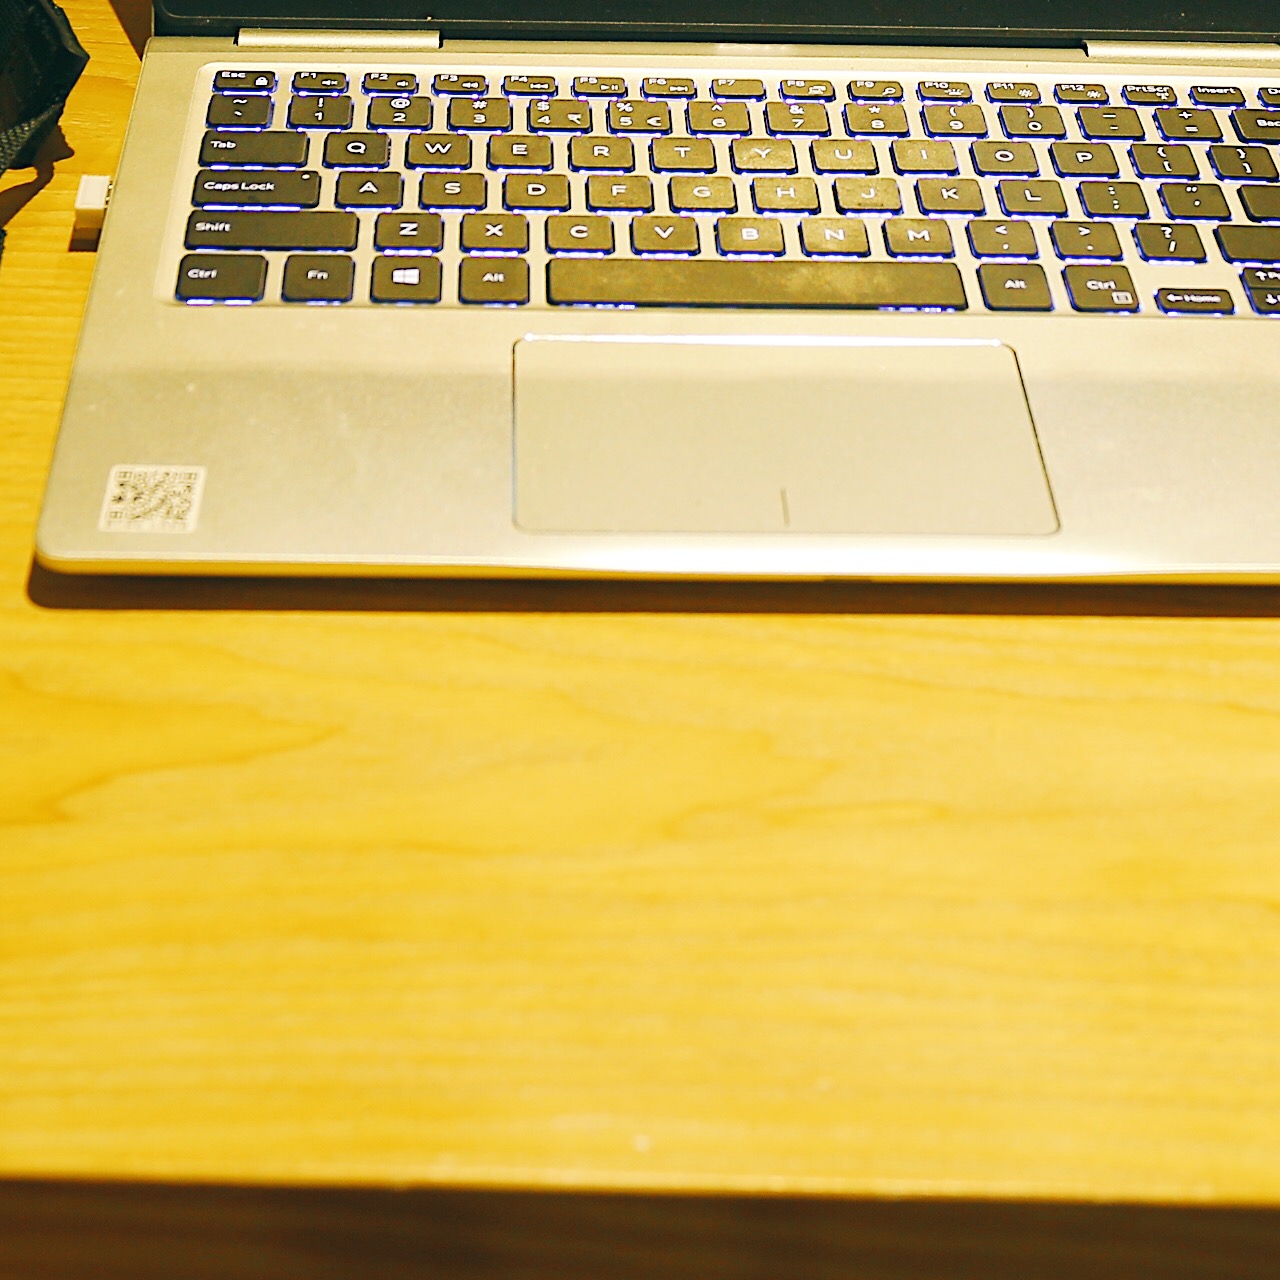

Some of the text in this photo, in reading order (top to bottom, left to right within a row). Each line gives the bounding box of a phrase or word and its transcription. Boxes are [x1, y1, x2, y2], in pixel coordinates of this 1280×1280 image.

[221, 71, 246, 79] Esc
[440, 74, 458, 82] F3
[1197, 86, 1236, 94] Insert
[393, 112, 407, 122] 2
[473, 114, 487, 123] 3
[538, 116, 551, 125] 4
[620, 116, 633, 126] 5
[712, 118, 726, 128] 6
[792, 119, 805, 128] 7
[870, 119, 885, 129] 8
[949, 120, 964, 130] 9
[210, 140, 237, 150] Tab
[346, 142, 366, 155] Q
[425, 142, 452, 154] W
[512, 144, 527, 155] E
[594, 146, 610, 157] R
[674, 147, 691, 157] T
[754, 148, 771, 159] Y
[835, 149, 852, 159] U
[995, 150, 1014, 162] O
[1075, 151, 1093, 162] P
[203, 181, 275, 192] Caps Lock
[359, 181, 379, 194] A
[444, 182, 461, 194] S
[527, 183, 547, 195] D
[612, 185, 628, 196] F
[693, 185, 712, 198] G
[776, 187, 796, 198] H
[860, 188, 876, 199] J
[941, 187, 960, 200] K
[1024, 189, 1042, 202] L
[195, 222, 232, 232] Shift
[399, 223, 418, 236] Z
[485, 223, 504, 237] X
[570, 225, 588, 238] C
[653, 226, 675, 239] V
[741, 227, 759, 240] B
[824, 229, 846, 241] N
[907, 230, 930, 242] M
[187, 268, 218, 280] Ctrl
[306, 270, 329, 280] Fn
[482, 272, 505, 282] Alt
[1004, 279, 1027, 290] Alt
[1086, 280, 1116, 290] Ctrl
[1183, 294, 1222, 303] Home
